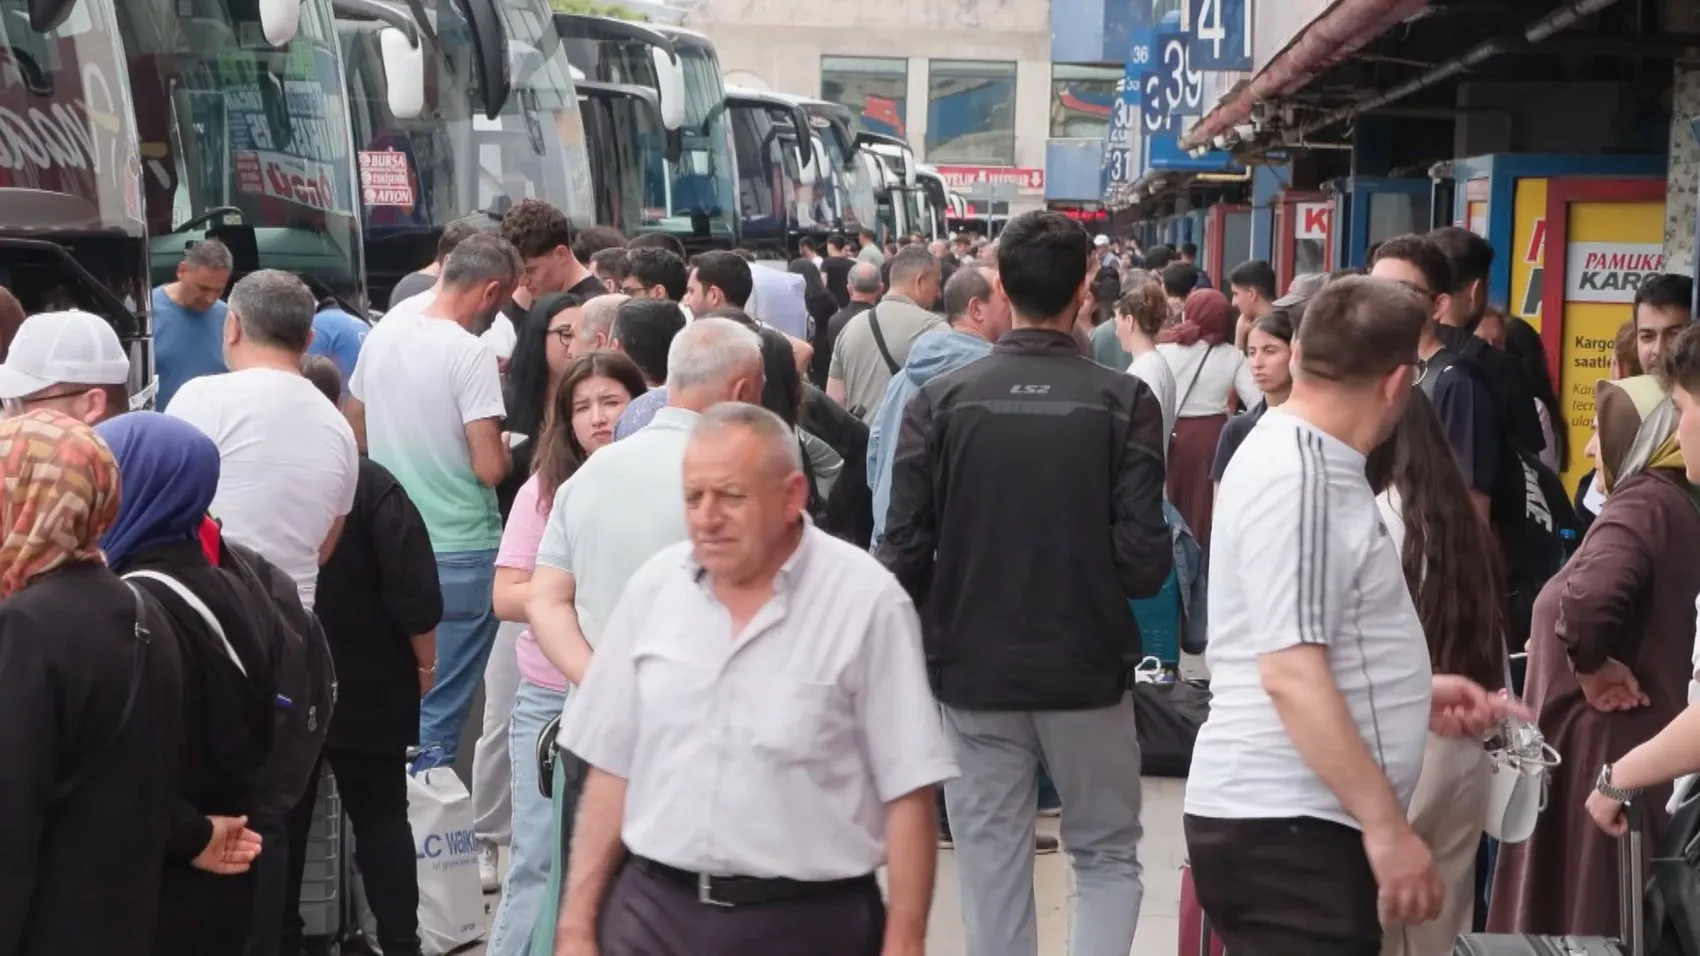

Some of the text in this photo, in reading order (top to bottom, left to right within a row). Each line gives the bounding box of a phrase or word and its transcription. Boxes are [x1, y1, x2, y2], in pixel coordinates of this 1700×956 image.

[1164, 40, 1203, 108] 39
[371, 154, 405, 169] BURSA
[1575, 335, 1615, 352] Kargo
[1010, 384, 1051, 394] LS2
